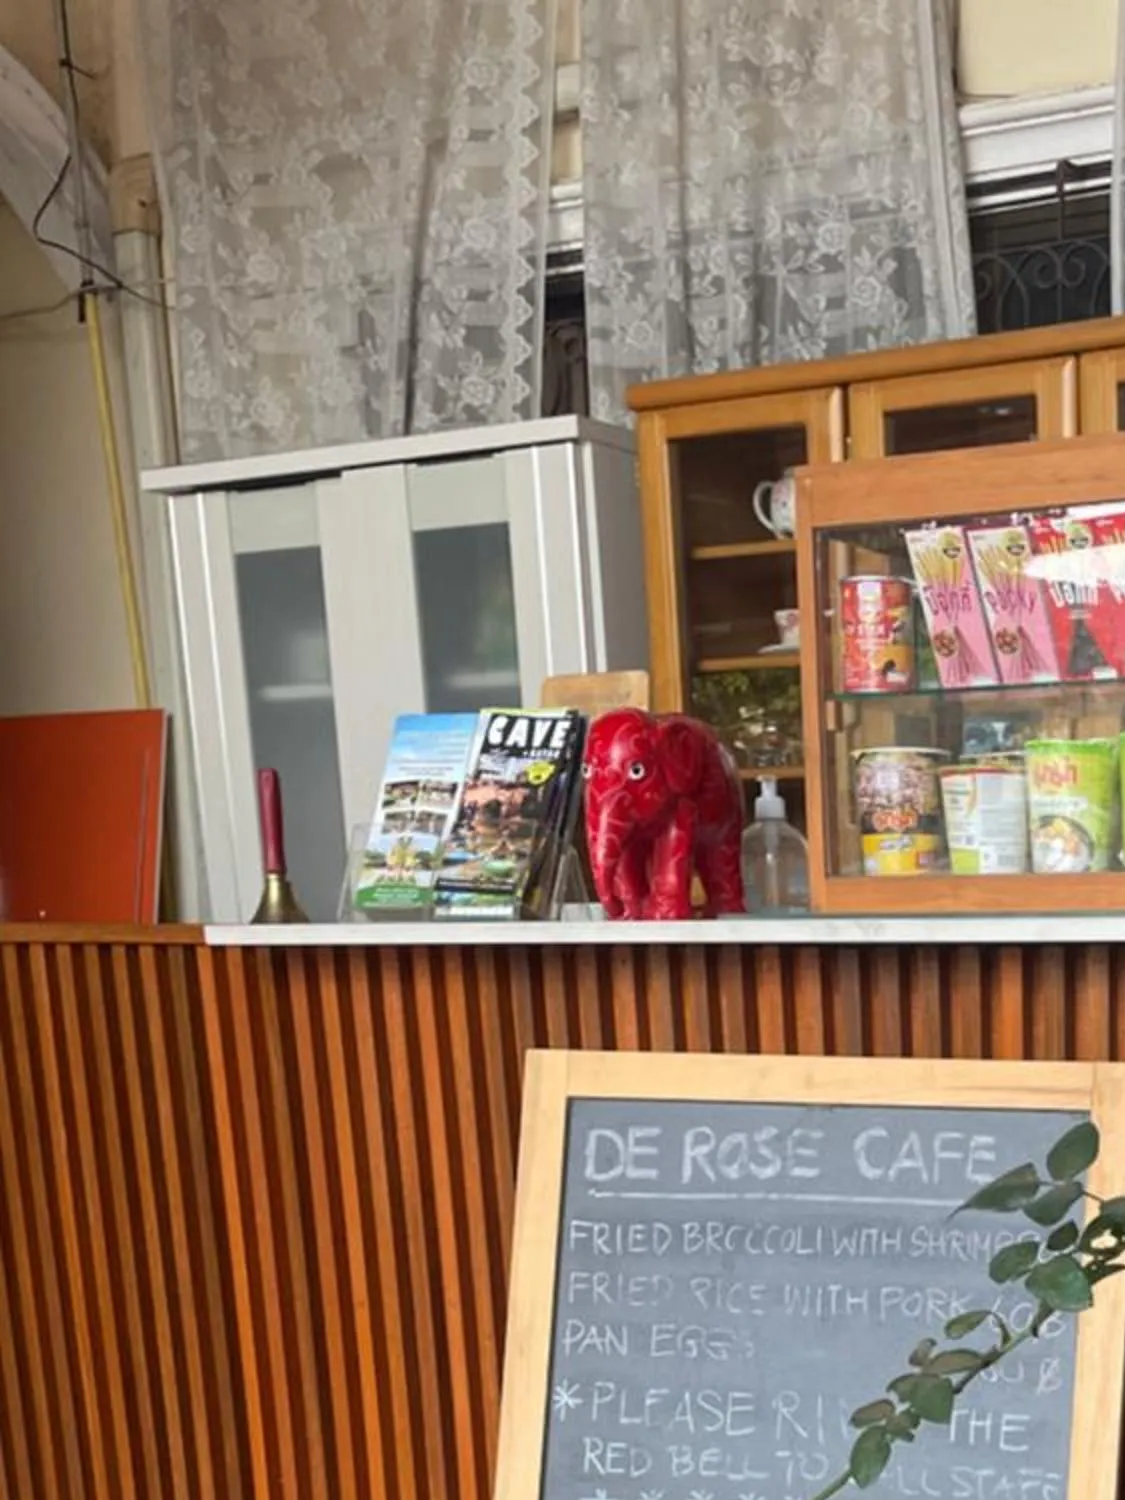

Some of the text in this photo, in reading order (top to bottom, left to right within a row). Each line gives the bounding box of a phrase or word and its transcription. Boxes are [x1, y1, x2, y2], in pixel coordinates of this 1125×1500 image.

[487, 715, 572, 749] CAVE
[583, 1125, 997, 1186] DE ROSE CAFE
[569, 1219, 673, 1257] FRIED
[567, 1271, 676, 1308] FRIED
[689, 1276, 767, 1316] RICE
[783, 1283, 869, 1317] WITH
[878, 1287, 972, 1323] PORK
[561, 1318, 629, 1358] PAN
[950, 1407, 1033, 1453] THE
[581, 1436, 653, 1479] RED
[666, 1445, 771, 1481] BELL
[774, 1449, 831, 1487] TO
